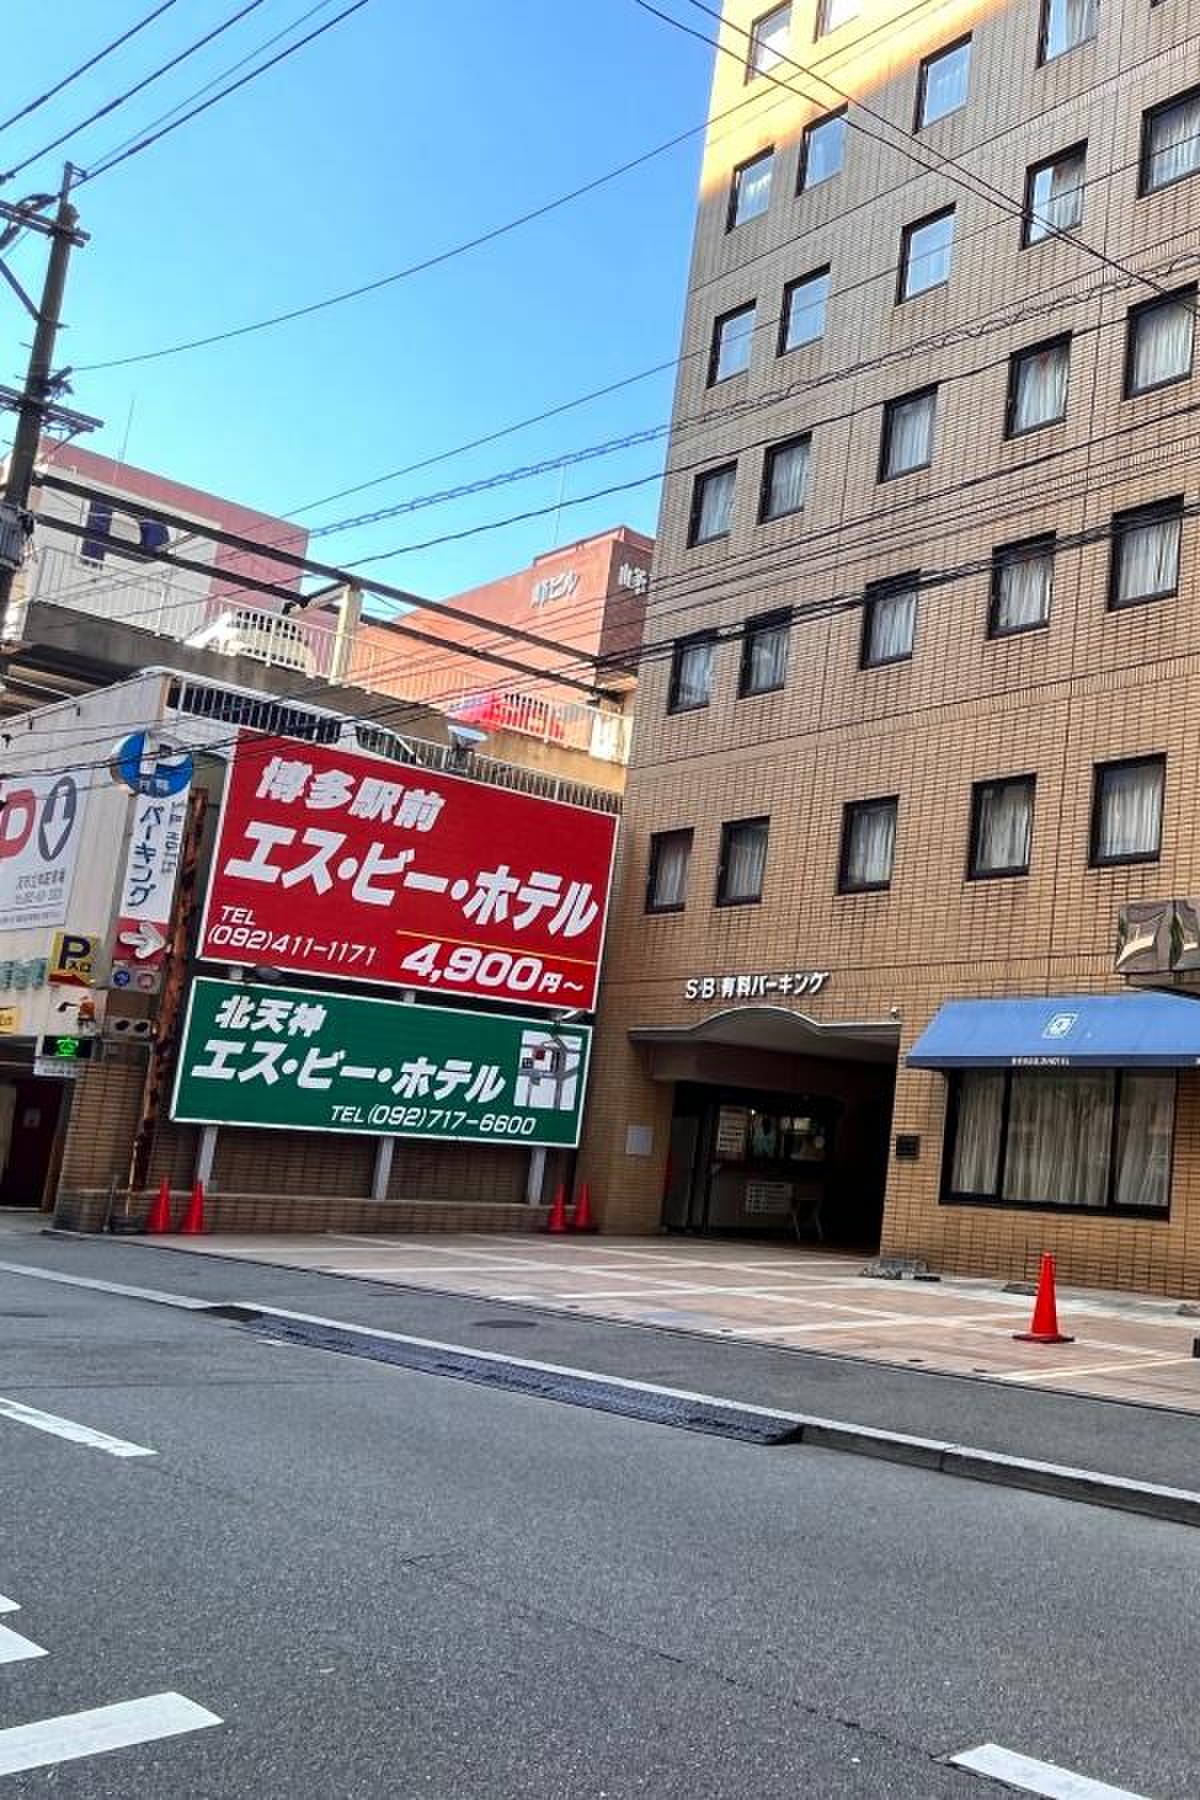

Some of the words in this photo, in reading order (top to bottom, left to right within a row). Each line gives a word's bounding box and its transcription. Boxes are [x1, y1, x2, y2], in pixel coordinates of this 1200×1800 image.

[255, 756, 446, 833] 博多駅前
[127, 805, 164, 907] パーキング
[223, 820, 599, 939] エス・ビー・ホテル
[220, 905, 256, 926] TEL
[58, 935, 91, 970] P
[207, 926, 378, 966] (092)411-1171
[721, 971, 830, 998] 有料パーキング
[214, 995, 328, 1038] 北天神
[56, 1038, 79, 1056] 空
[191, 1038, 507, 1104] エス・ビー・ホテル
[330, 1104, 365, 1123] TEL
[367, 1106, 537, 1136] (092)717-6600
